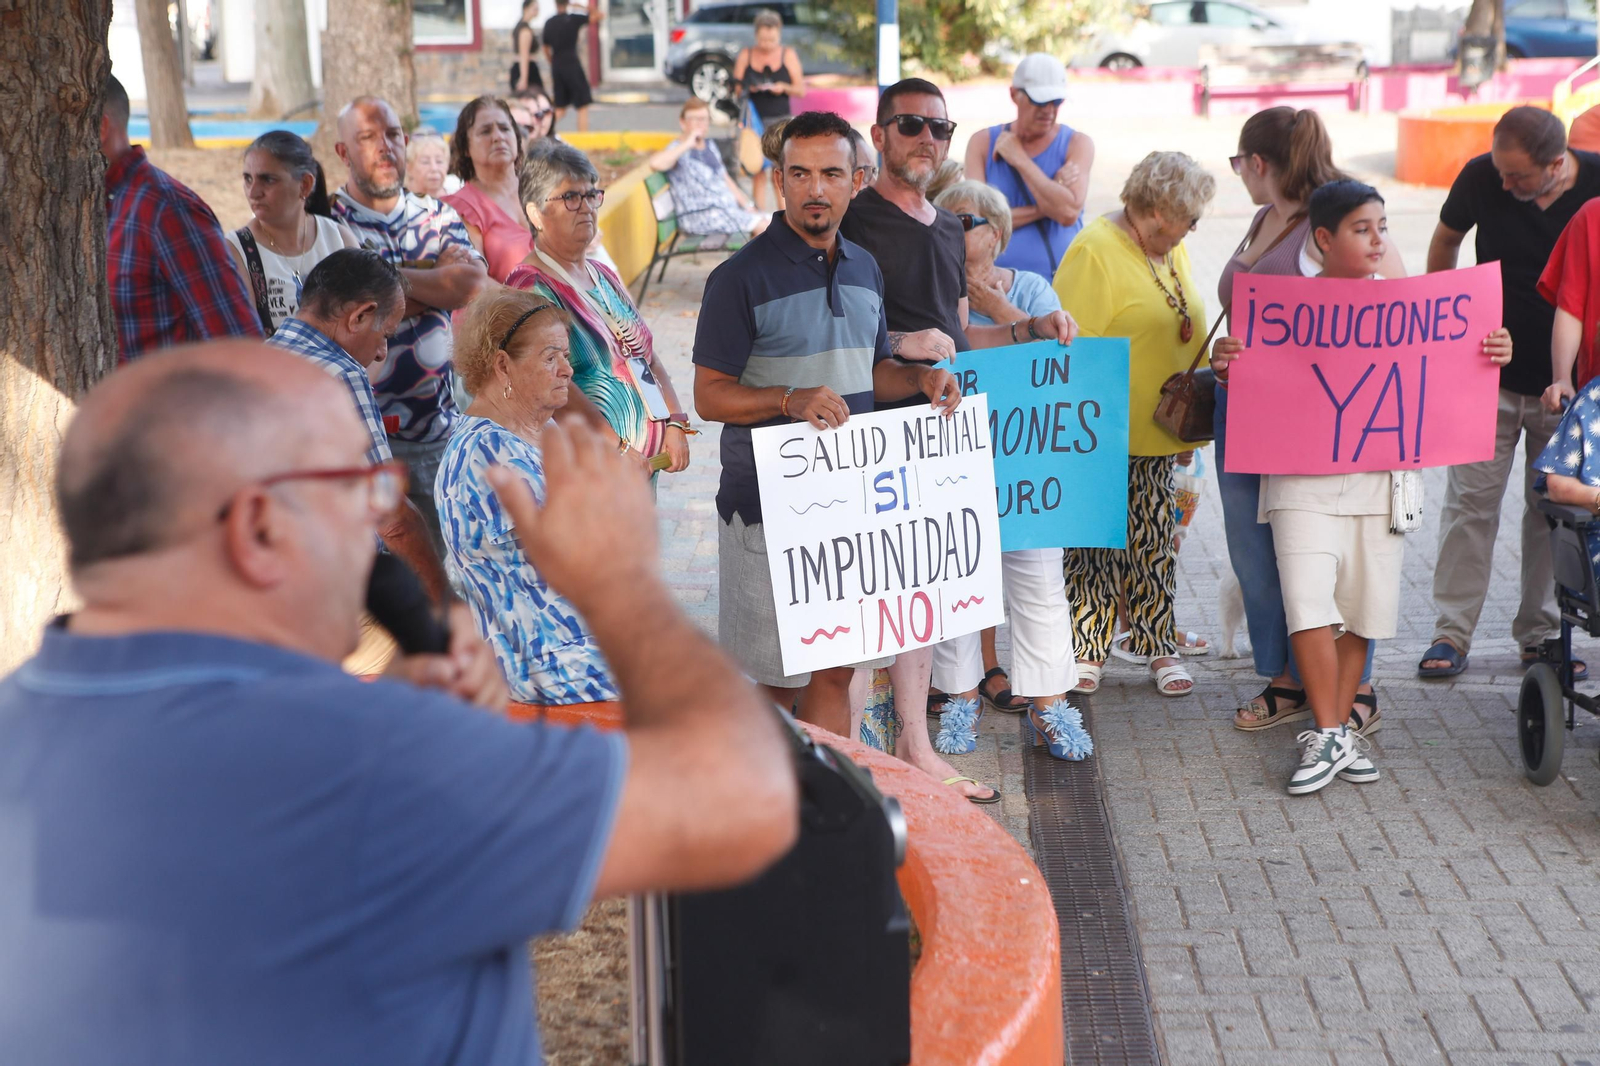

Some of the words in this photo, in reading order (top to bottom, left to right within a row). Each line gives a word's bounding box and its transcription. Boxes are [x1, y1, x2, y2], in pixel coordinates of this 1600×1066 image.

[1245, 287, 1472, 348] ¡SOLUCIONES
[1031, 353, 1071, 388] UN
[779, 426, 887, 478] SALUD
[903, 407, 986, 461] MENTAL
[1310, 355, 1428, 463] YA!
[783, 507, 981, 606] IMPUNIDAD
[858, 587, 944, 655] ¡NO!
